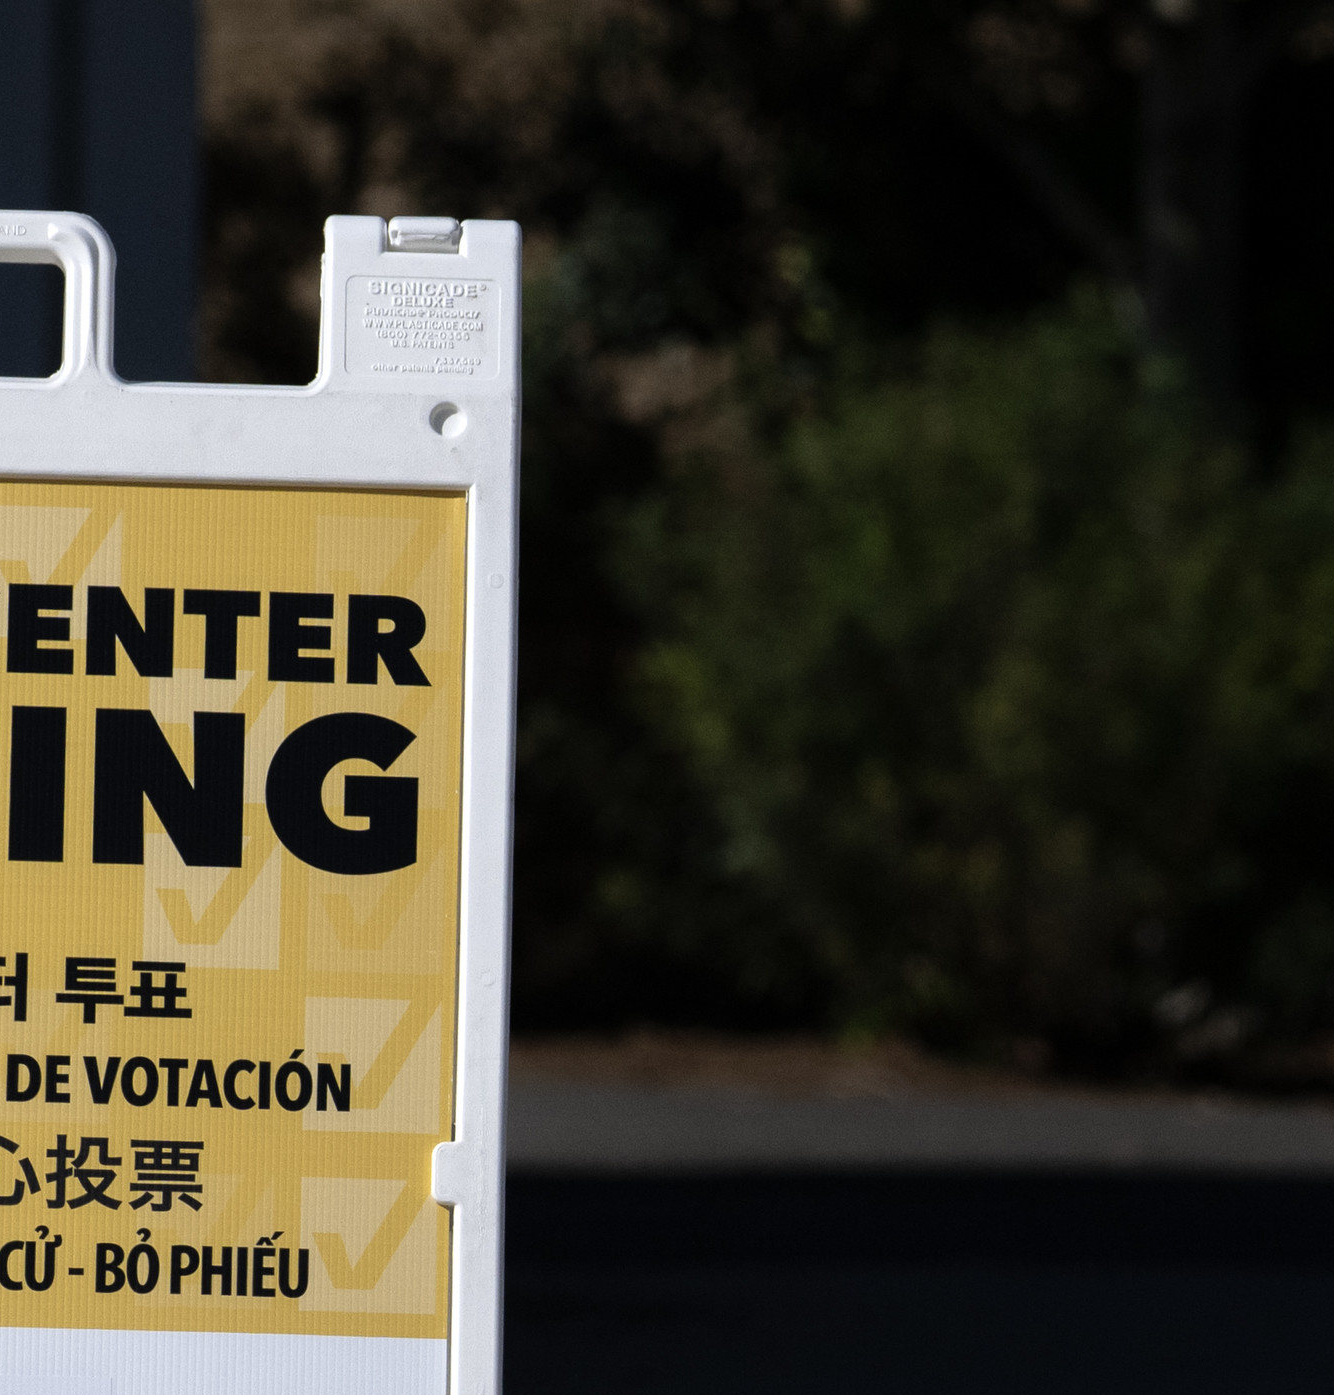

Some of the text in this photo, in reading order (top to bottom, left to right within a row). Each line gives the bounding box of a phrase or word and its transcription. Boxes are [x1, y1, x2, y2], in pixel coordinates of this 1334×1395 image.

[391, 296, 455, 309] DELUXE
[363, 318, 484, 332] WWW.PLASTICADE.COM
[371, 362, 399, 373] other
[56, 957, 192, 1024] 투표
[7, 1054, 70, 1103] DE
[83, 1049, 350, 1111] VOTACIÓN
[96, 1228, 159, 1294] BỎ
[171, 1232, 309, 1298] PHIẾU
